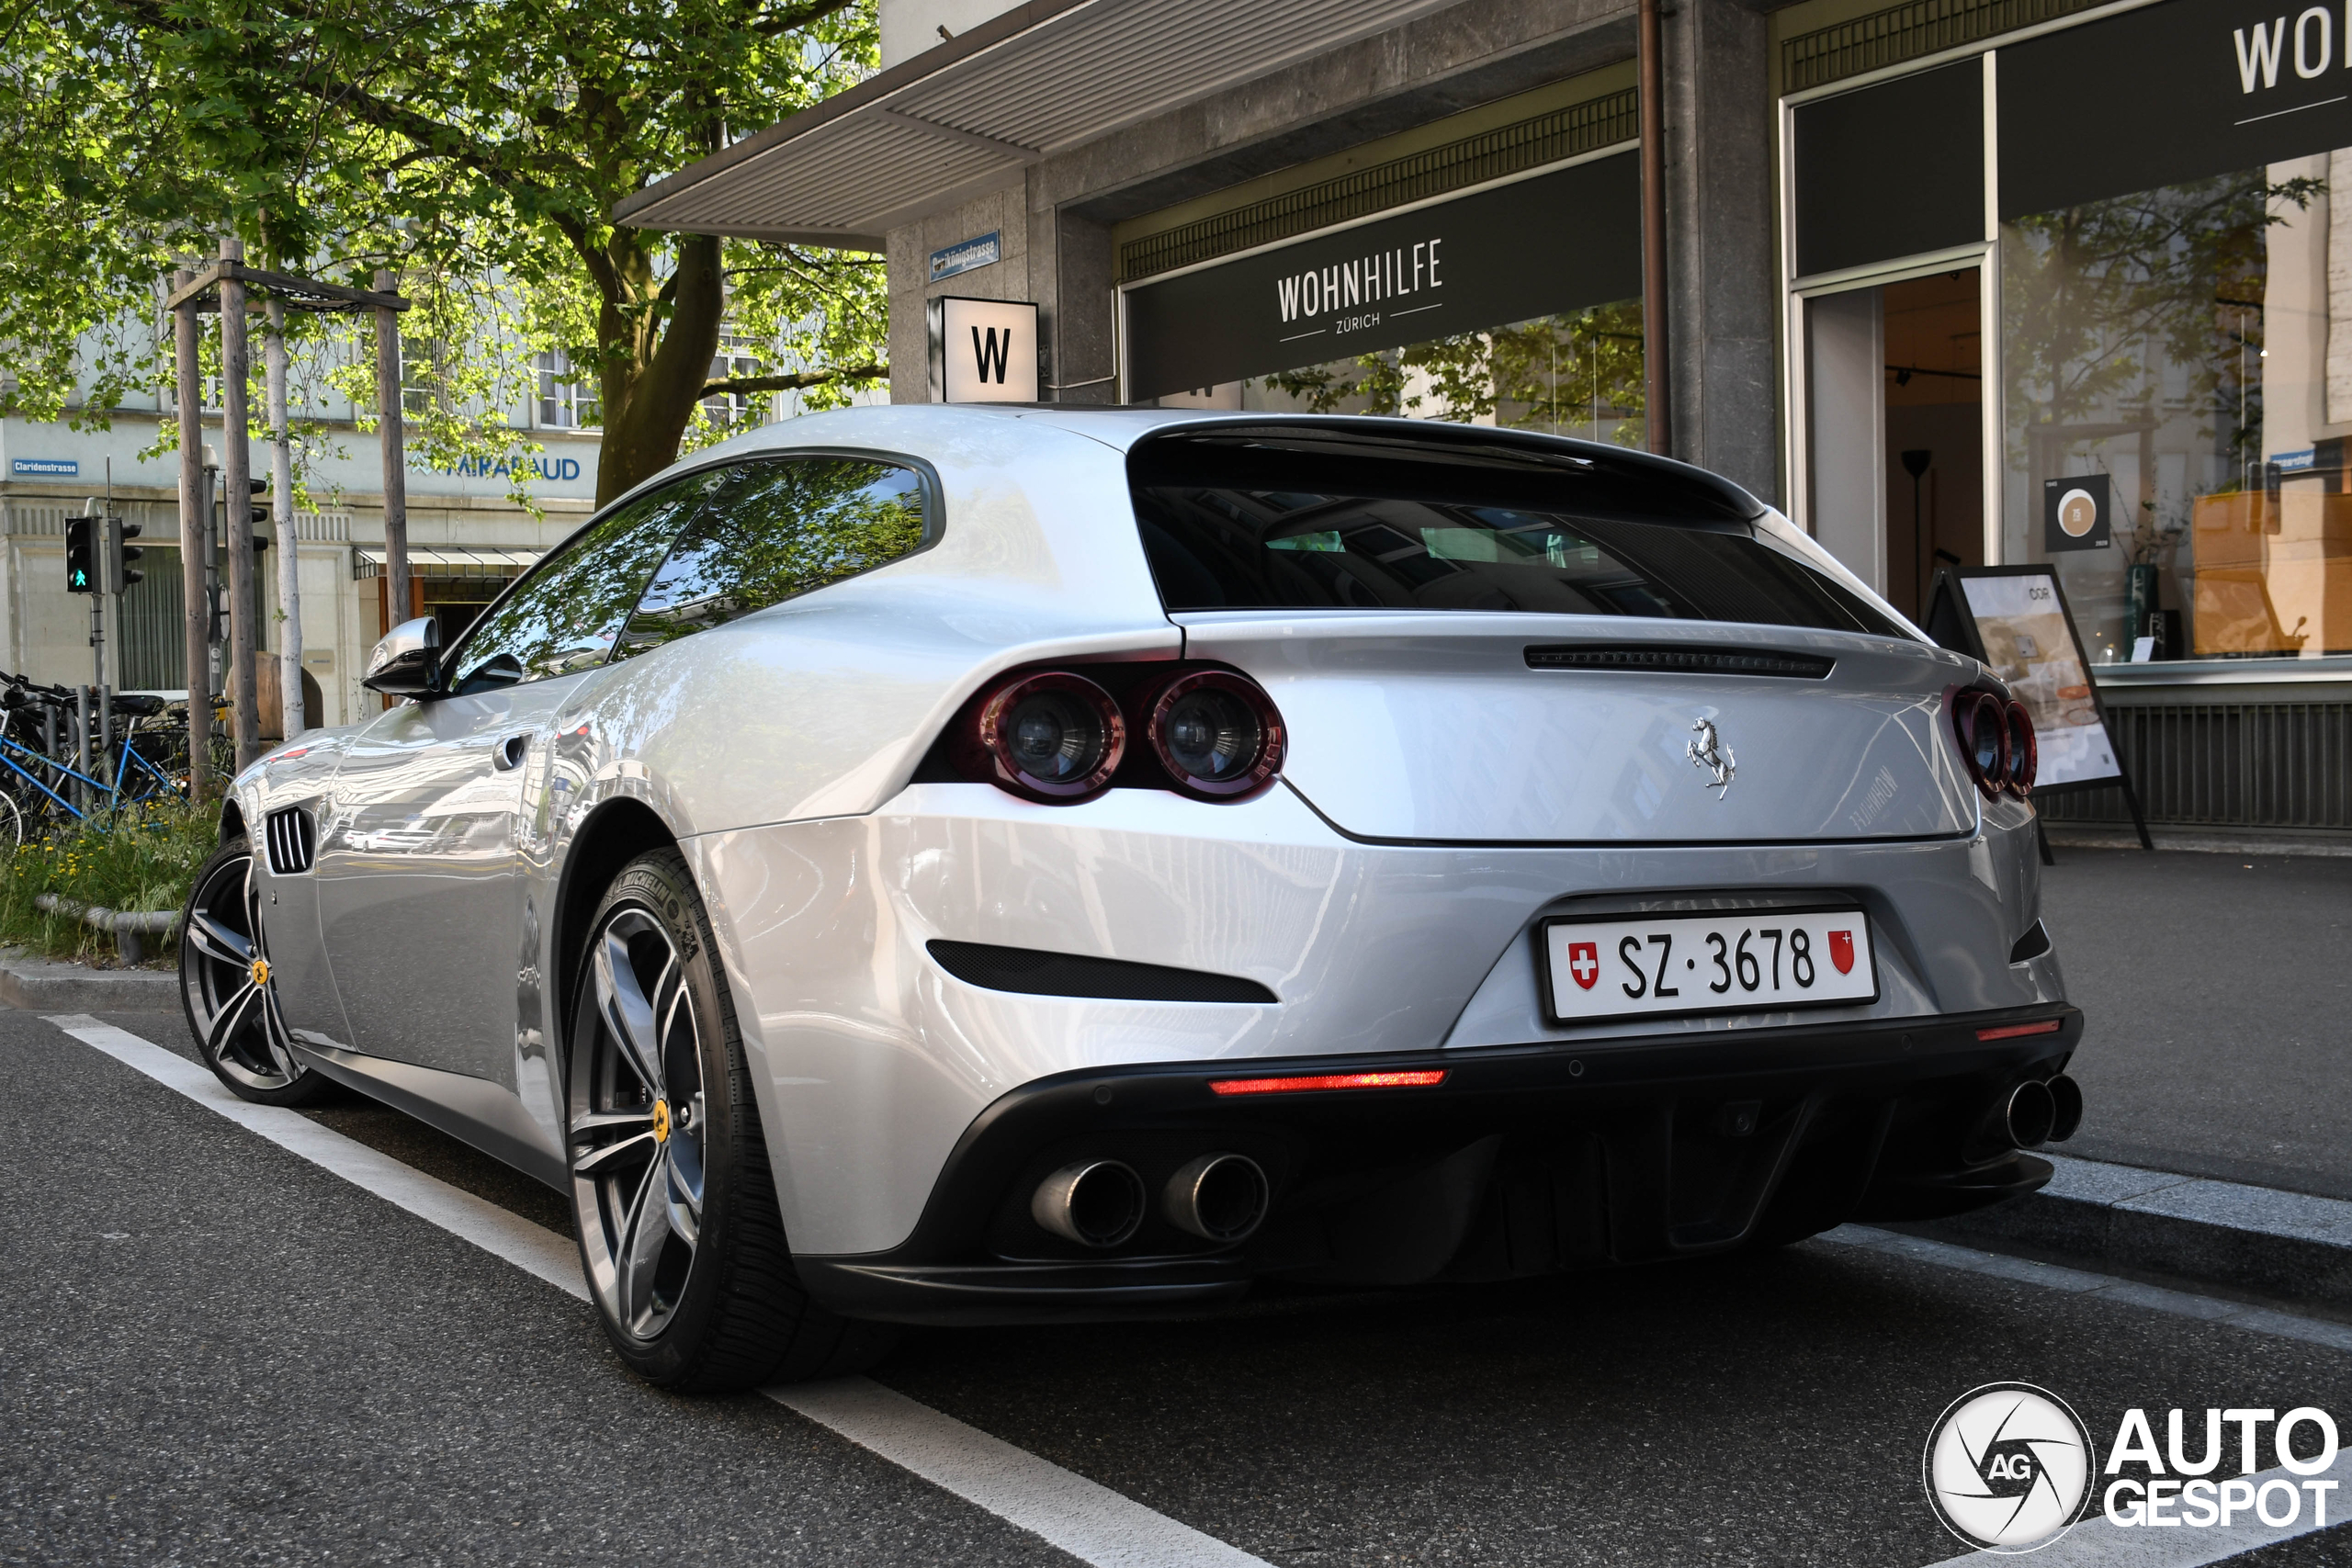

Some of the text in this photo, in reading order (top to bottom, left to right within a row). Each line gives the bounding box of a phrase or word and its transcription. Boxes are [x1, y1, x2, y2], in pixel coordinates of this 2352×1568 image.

[2233, 0, 2352, 95] WO
[1277, 238, 1442, 322] WOHNHILFE
[1336, 311, 1381, 334] ZÜRICH
[971, 326, 1011, 384] W
[15, 462, 76, 472] Claridenstrasse
[622, 872, 670, 902] MICHELIN
